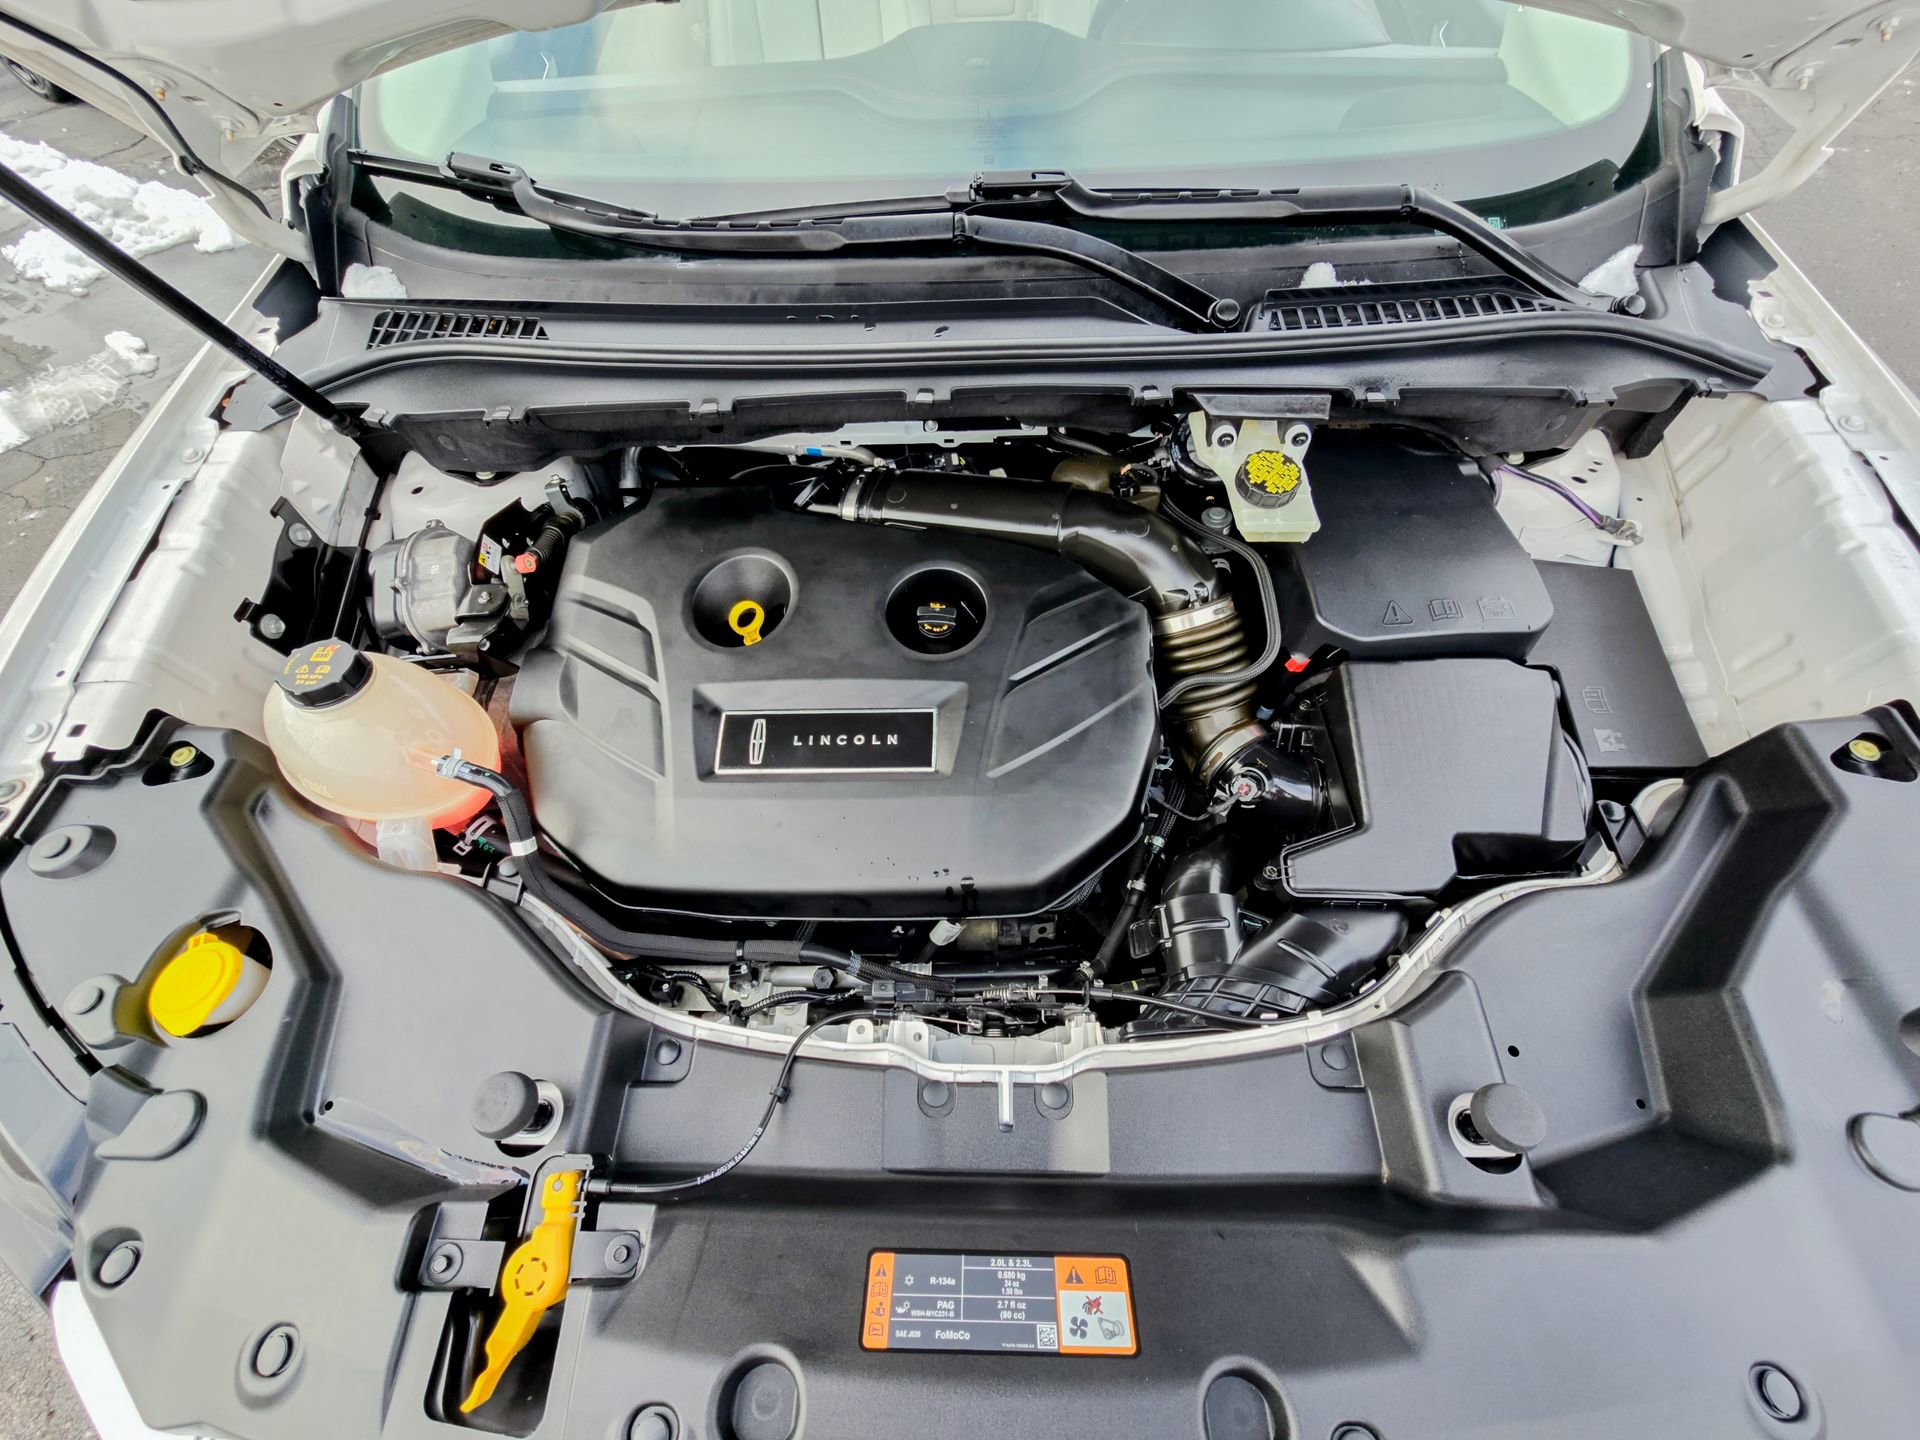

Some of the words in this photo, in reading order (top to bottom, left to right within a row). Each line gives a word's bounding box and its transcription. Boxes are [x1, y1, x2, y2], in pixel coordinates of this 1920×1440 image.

[792, 733, 899, 746] LINCOLN
[990, 1258, 1007, 1267] 2.0L
[1008, 1259, 1014, 1267] &
[1016, 1259, 1032, 1268] 2.3L
[930, 1276, 956, 1286] R-134a
[1016, 1271, 1026, 1282] kg
[1013, 1288, 1023, 1296] lbs
[937, 1300, 955, 1310] PAG
[997, 1300, 1008, 1309] 2.7
[1017, 1302, 1026, 1310] oz
[1000, 1311, 1012, 1321] (80
[1013, 1311, 1026, 1321] cc)
[935, 1329, 971, 1341] FoMoCo
